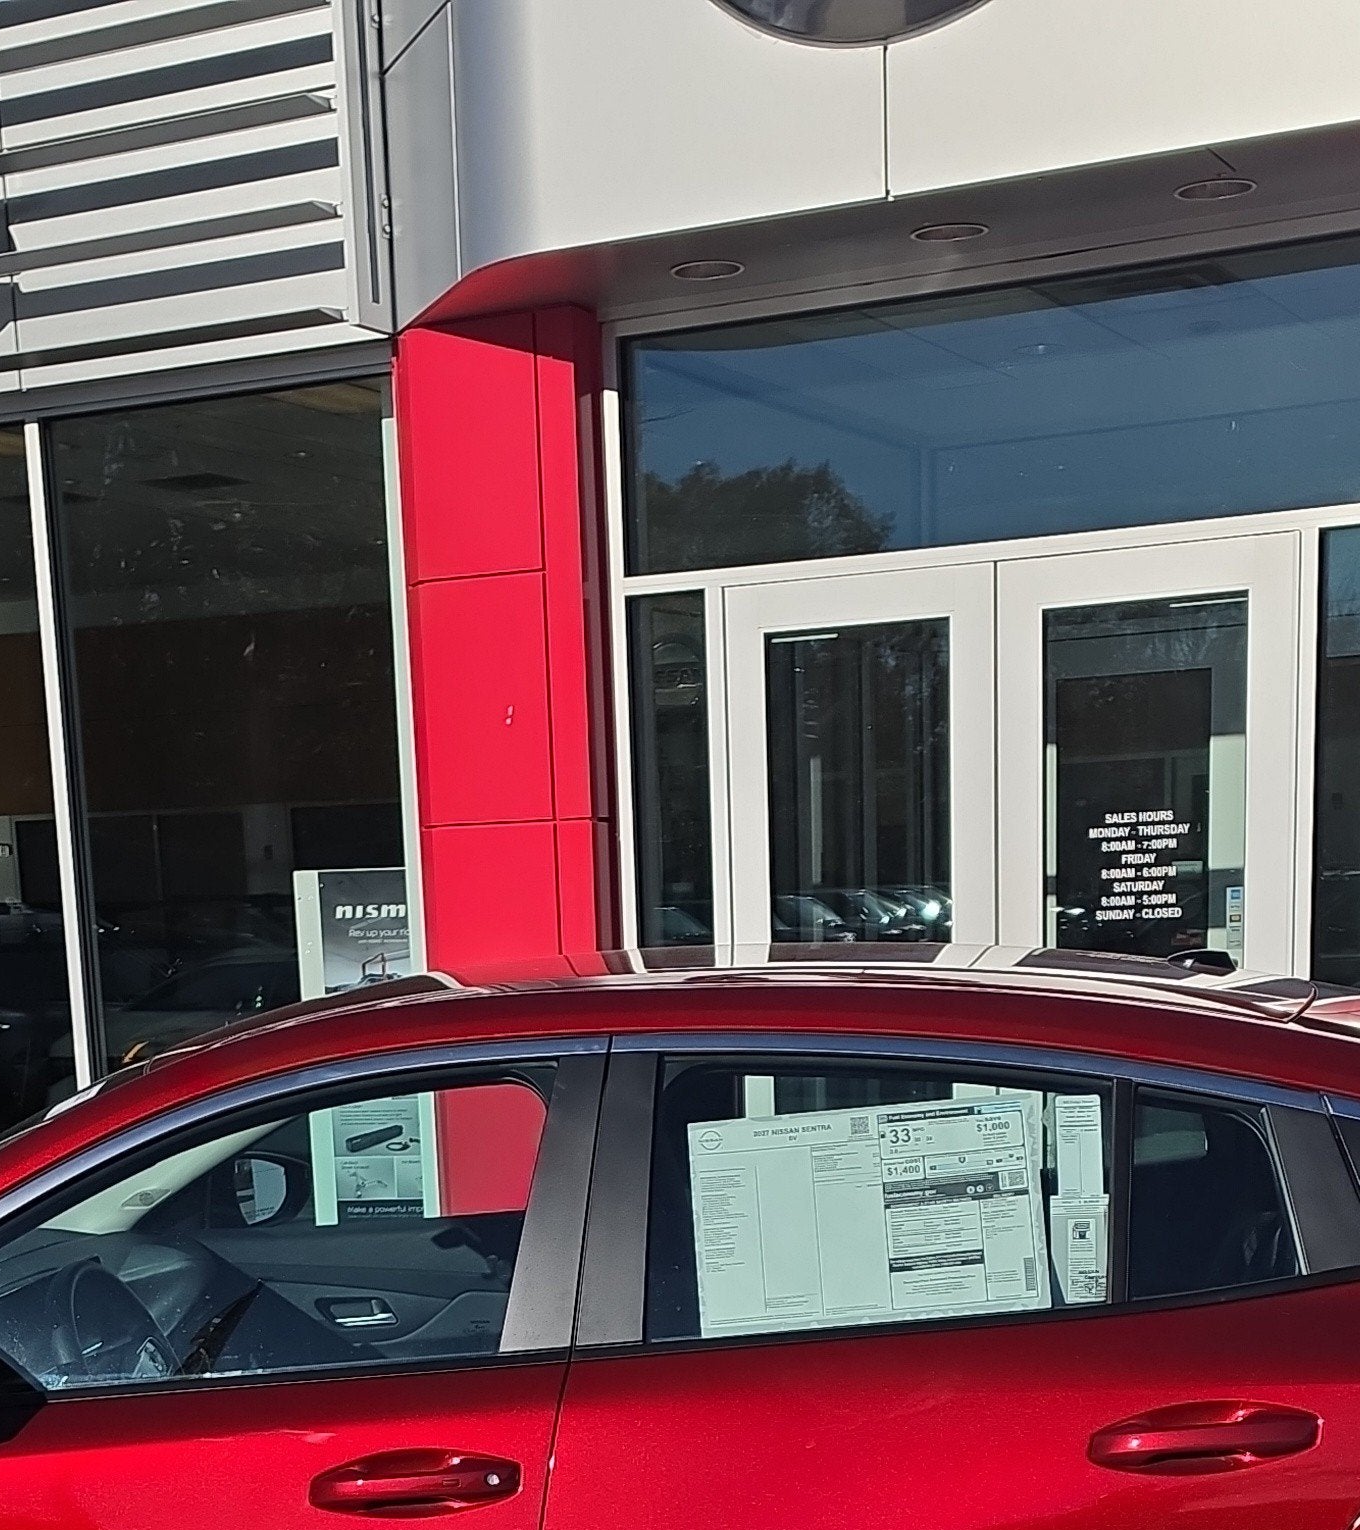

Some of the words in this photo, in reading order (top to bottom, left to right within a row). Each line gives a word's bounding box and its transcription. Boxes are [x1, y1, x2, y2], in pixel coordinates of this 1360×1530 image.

[1104, 812, 1137, 824] SALES
[1139, 810, 1174, 822] HOURS
[1088, 826, 1131, 839] MONDAY
[1137, 823, 1190, 836] THURSDAY
[1101, 840, 1135, 852] 8:00AM
[1142, 838, 1177, 850] 7:00PM
[1121, 853, 1157, 865] FRIDAY
[1101, 868, 1135, 879] 8:00AM
[1142, 866, 1177, 877] 6:00PM
[1113, 880, 1165, 893] SATURDAY
[1101, 895, 1135, 907] 8:00AM
[1142, 893, 1177, 905] 5:00PM
[1095, 909, 1135, 920] SUNDAY
[1142, 907, 1183, 919] CLOSED
[976, 1121, 1010, 1132] $1,000
[889, 1127, 911, 1144] 33
[887, 1164, 920, 1176] $1,400
